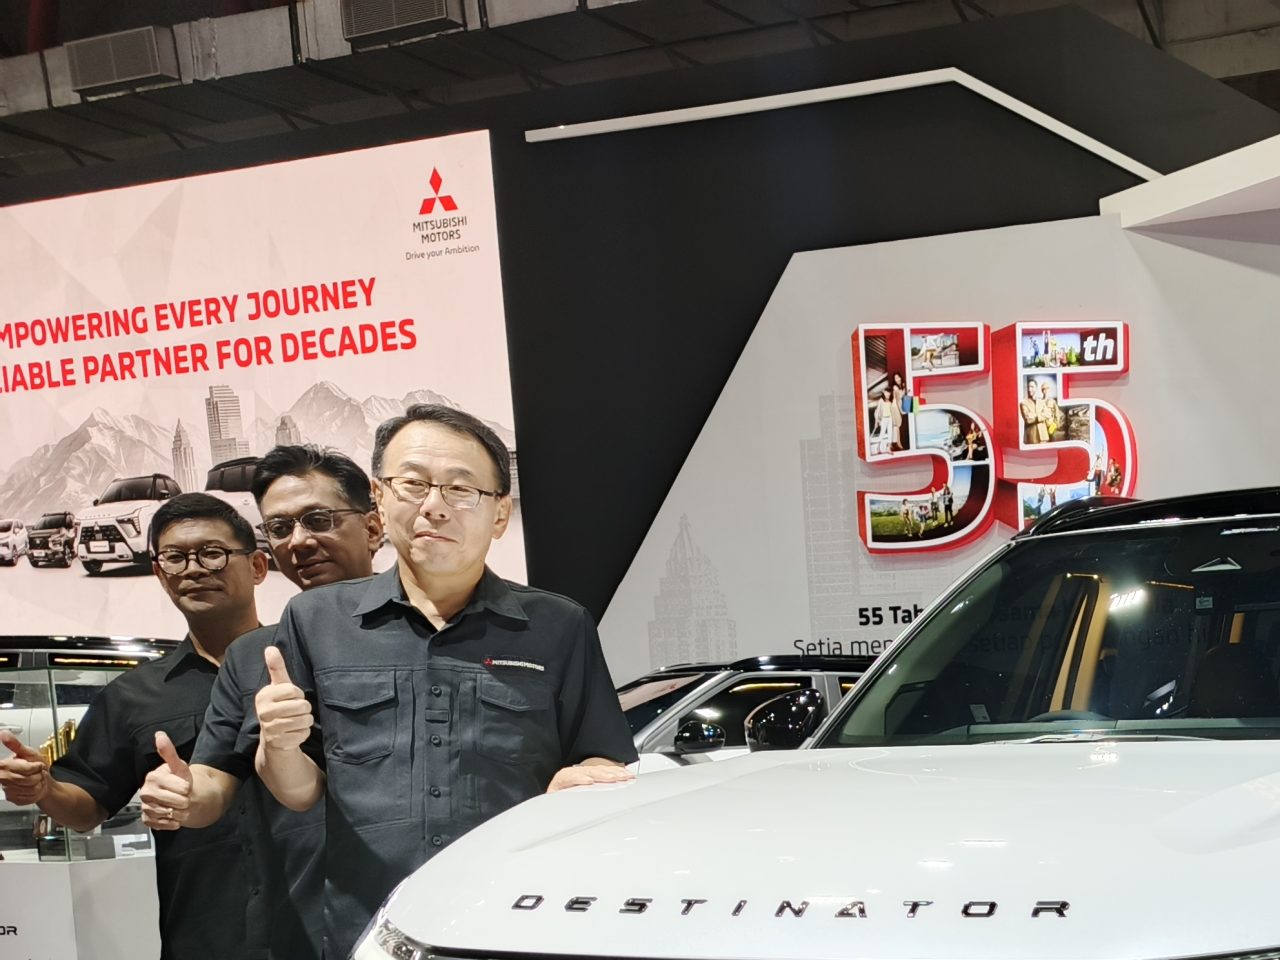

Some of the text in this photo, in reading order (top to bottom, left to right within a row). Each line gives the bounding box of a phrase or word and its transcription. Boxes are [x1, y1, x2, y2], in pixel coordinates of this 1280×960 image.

[413, 216, 467, 232] MITSUBISHI
[421, 230, 461, 244] MOTORS
[405, 245, 480, 260] Drive your Ambition
[154, 295, 238, 331] EVERY
[247, 277, 376, 320] JOURNEY
[0, 319, 416, 393] IABLE PARTNER FOR DECADES
[858, 607, 884, 626] 55
[793, 637, 843, 656] Setia
[511, 894, 1070, 918] DESTINATOR
